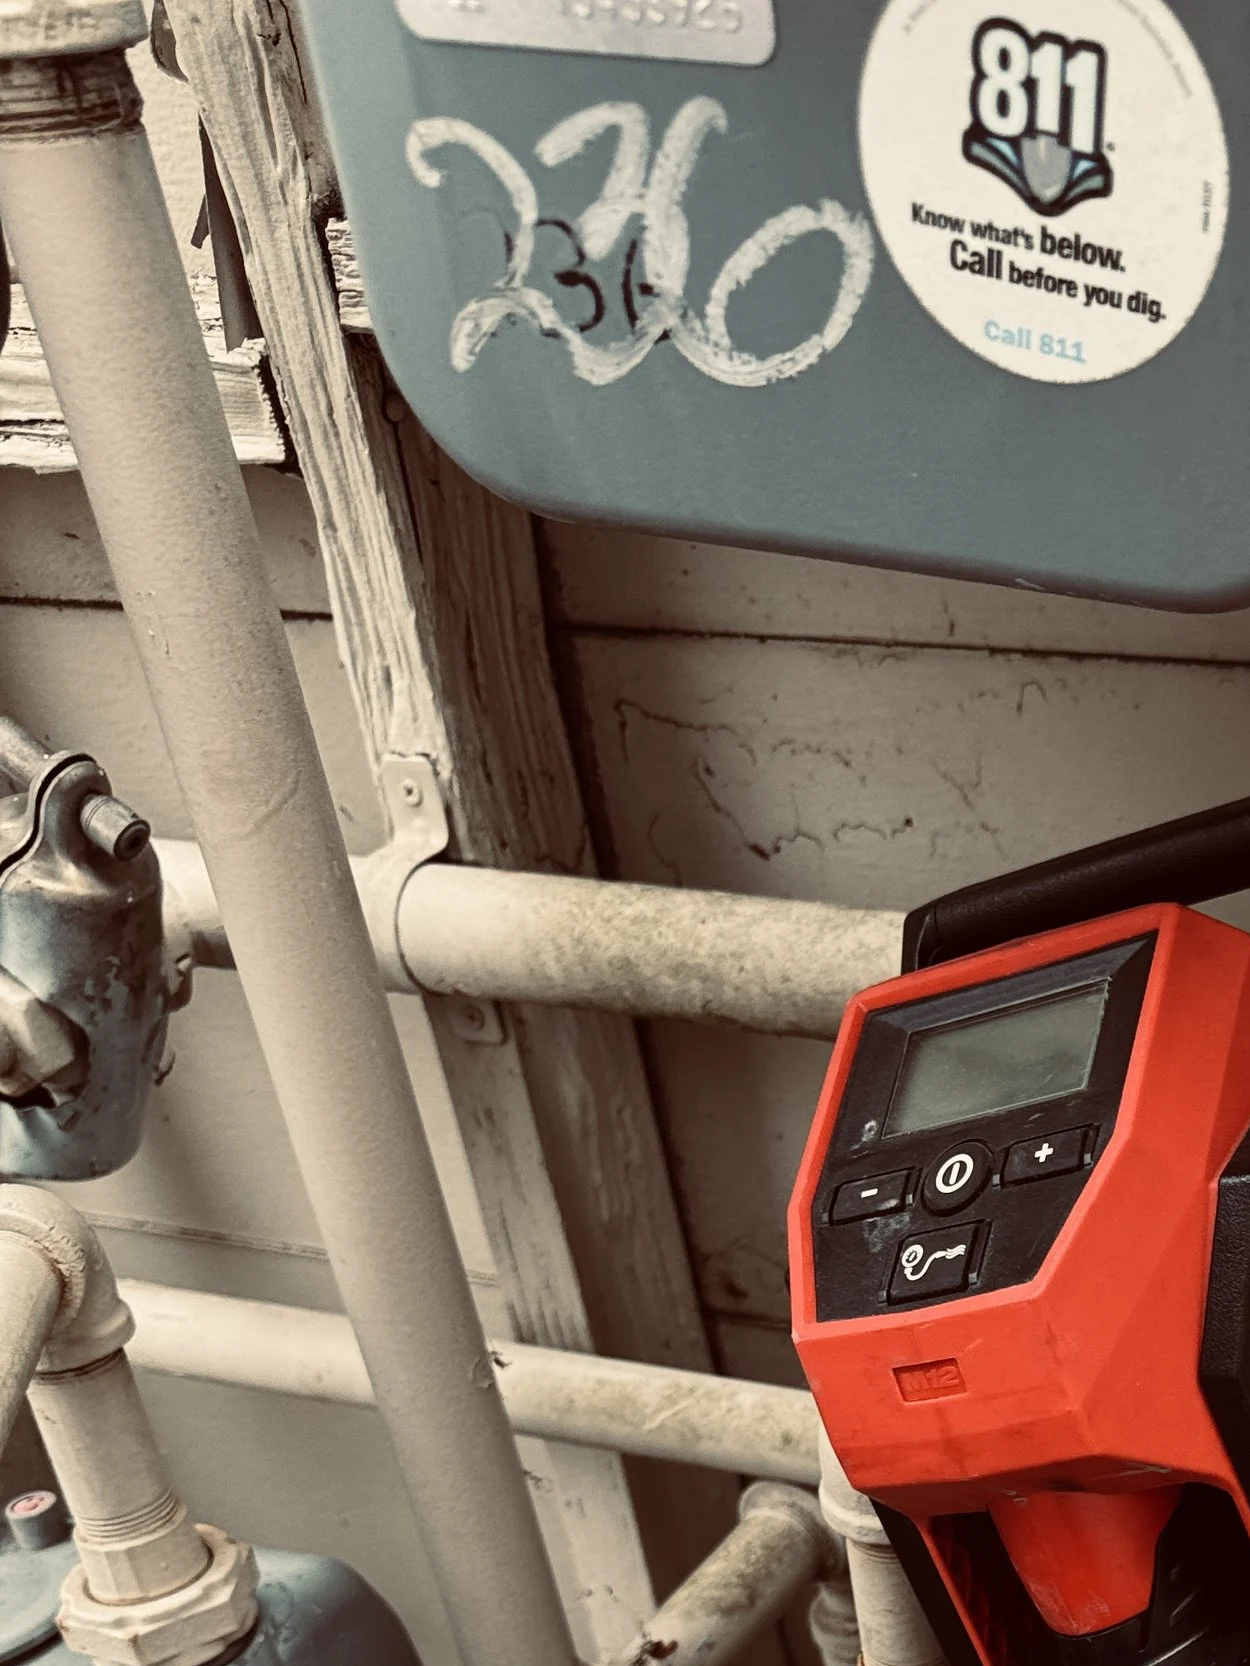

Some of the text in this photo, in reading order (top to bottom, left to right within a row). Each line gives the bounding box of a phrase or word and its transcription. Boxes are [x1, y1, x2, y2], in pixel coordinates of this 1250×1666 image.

[976, 25, 1100, 154] 811
[911, 202, 1126, 273] Know what's below.
[950, 239, 1168, 324] Call before you dig.
[984, 319, 1086, 364] Call 811
[902, 1365, 961, 1393] M12
